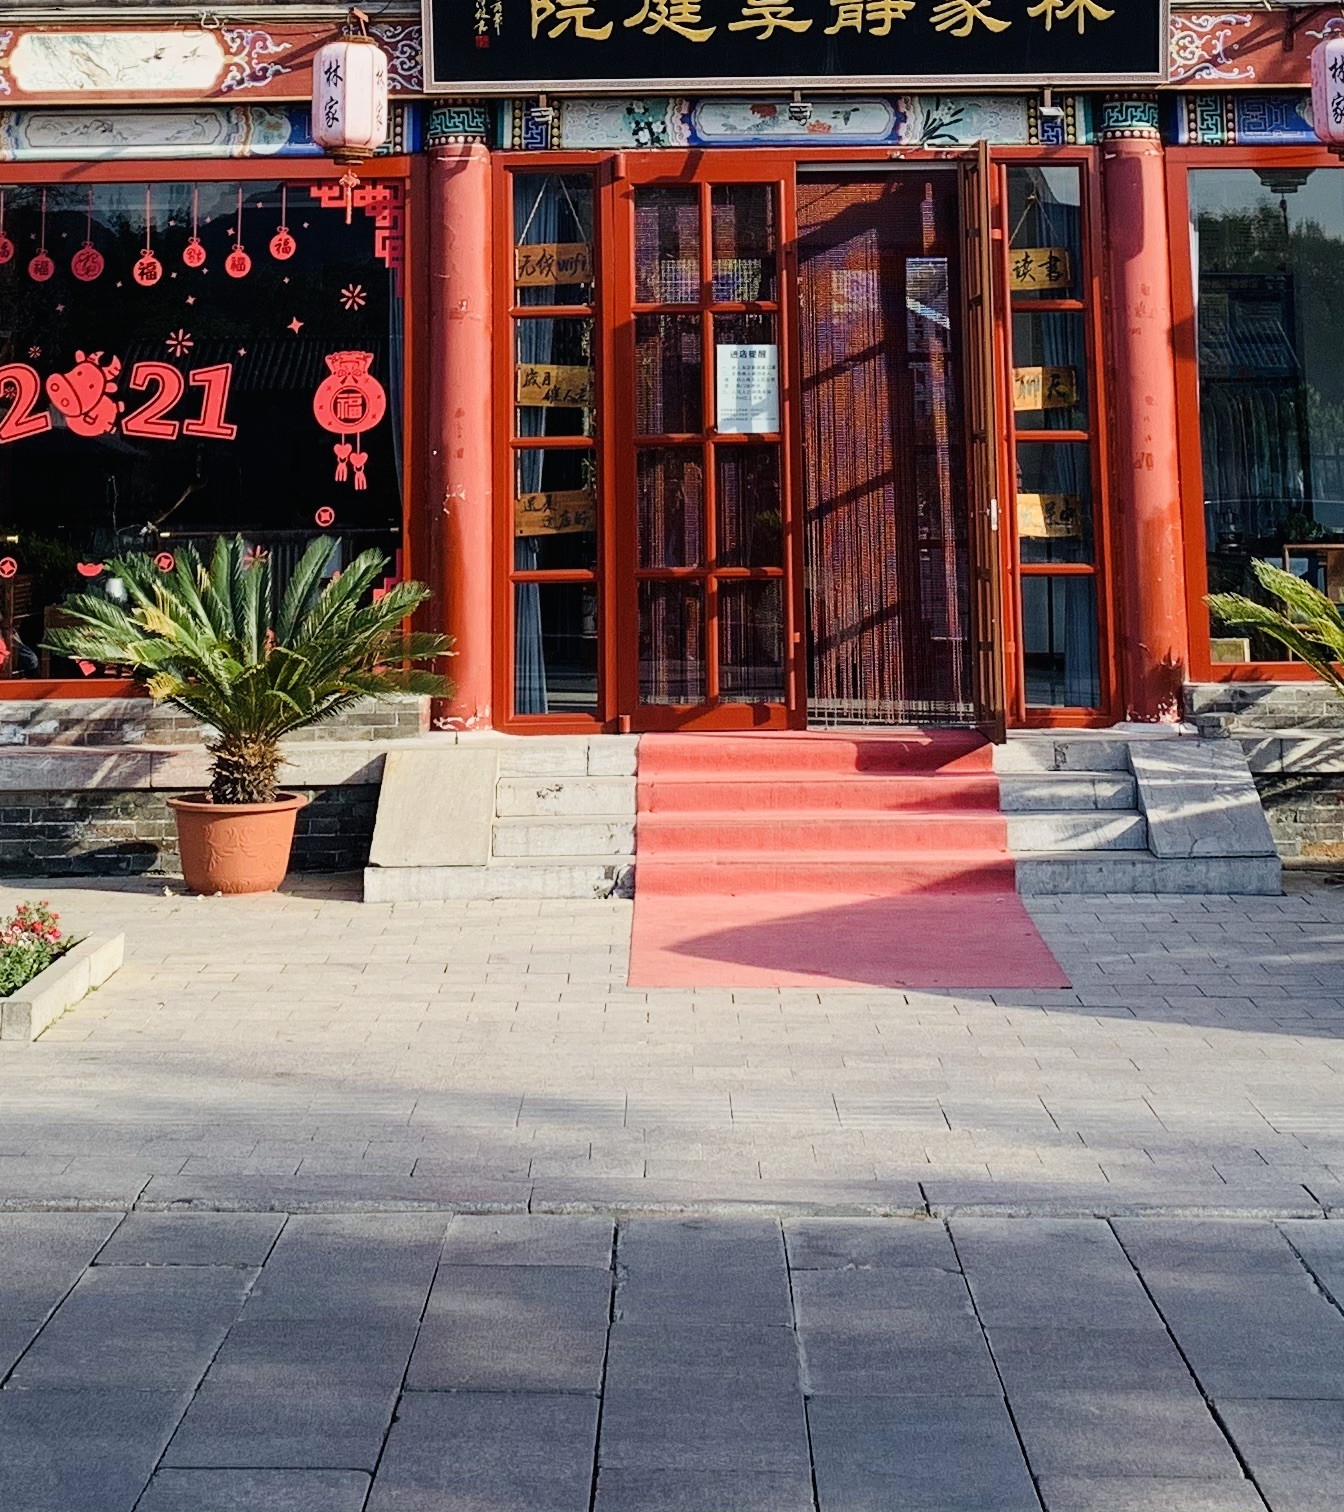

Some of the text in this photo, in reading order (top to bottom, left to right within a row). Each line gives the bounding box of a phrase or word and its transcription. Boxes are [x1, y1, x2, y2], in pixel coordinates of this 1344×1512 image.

[324, 58, 344, 129] 林家
[138, 262, 157, 280] 福
[337, 394, 363, 419] 福
